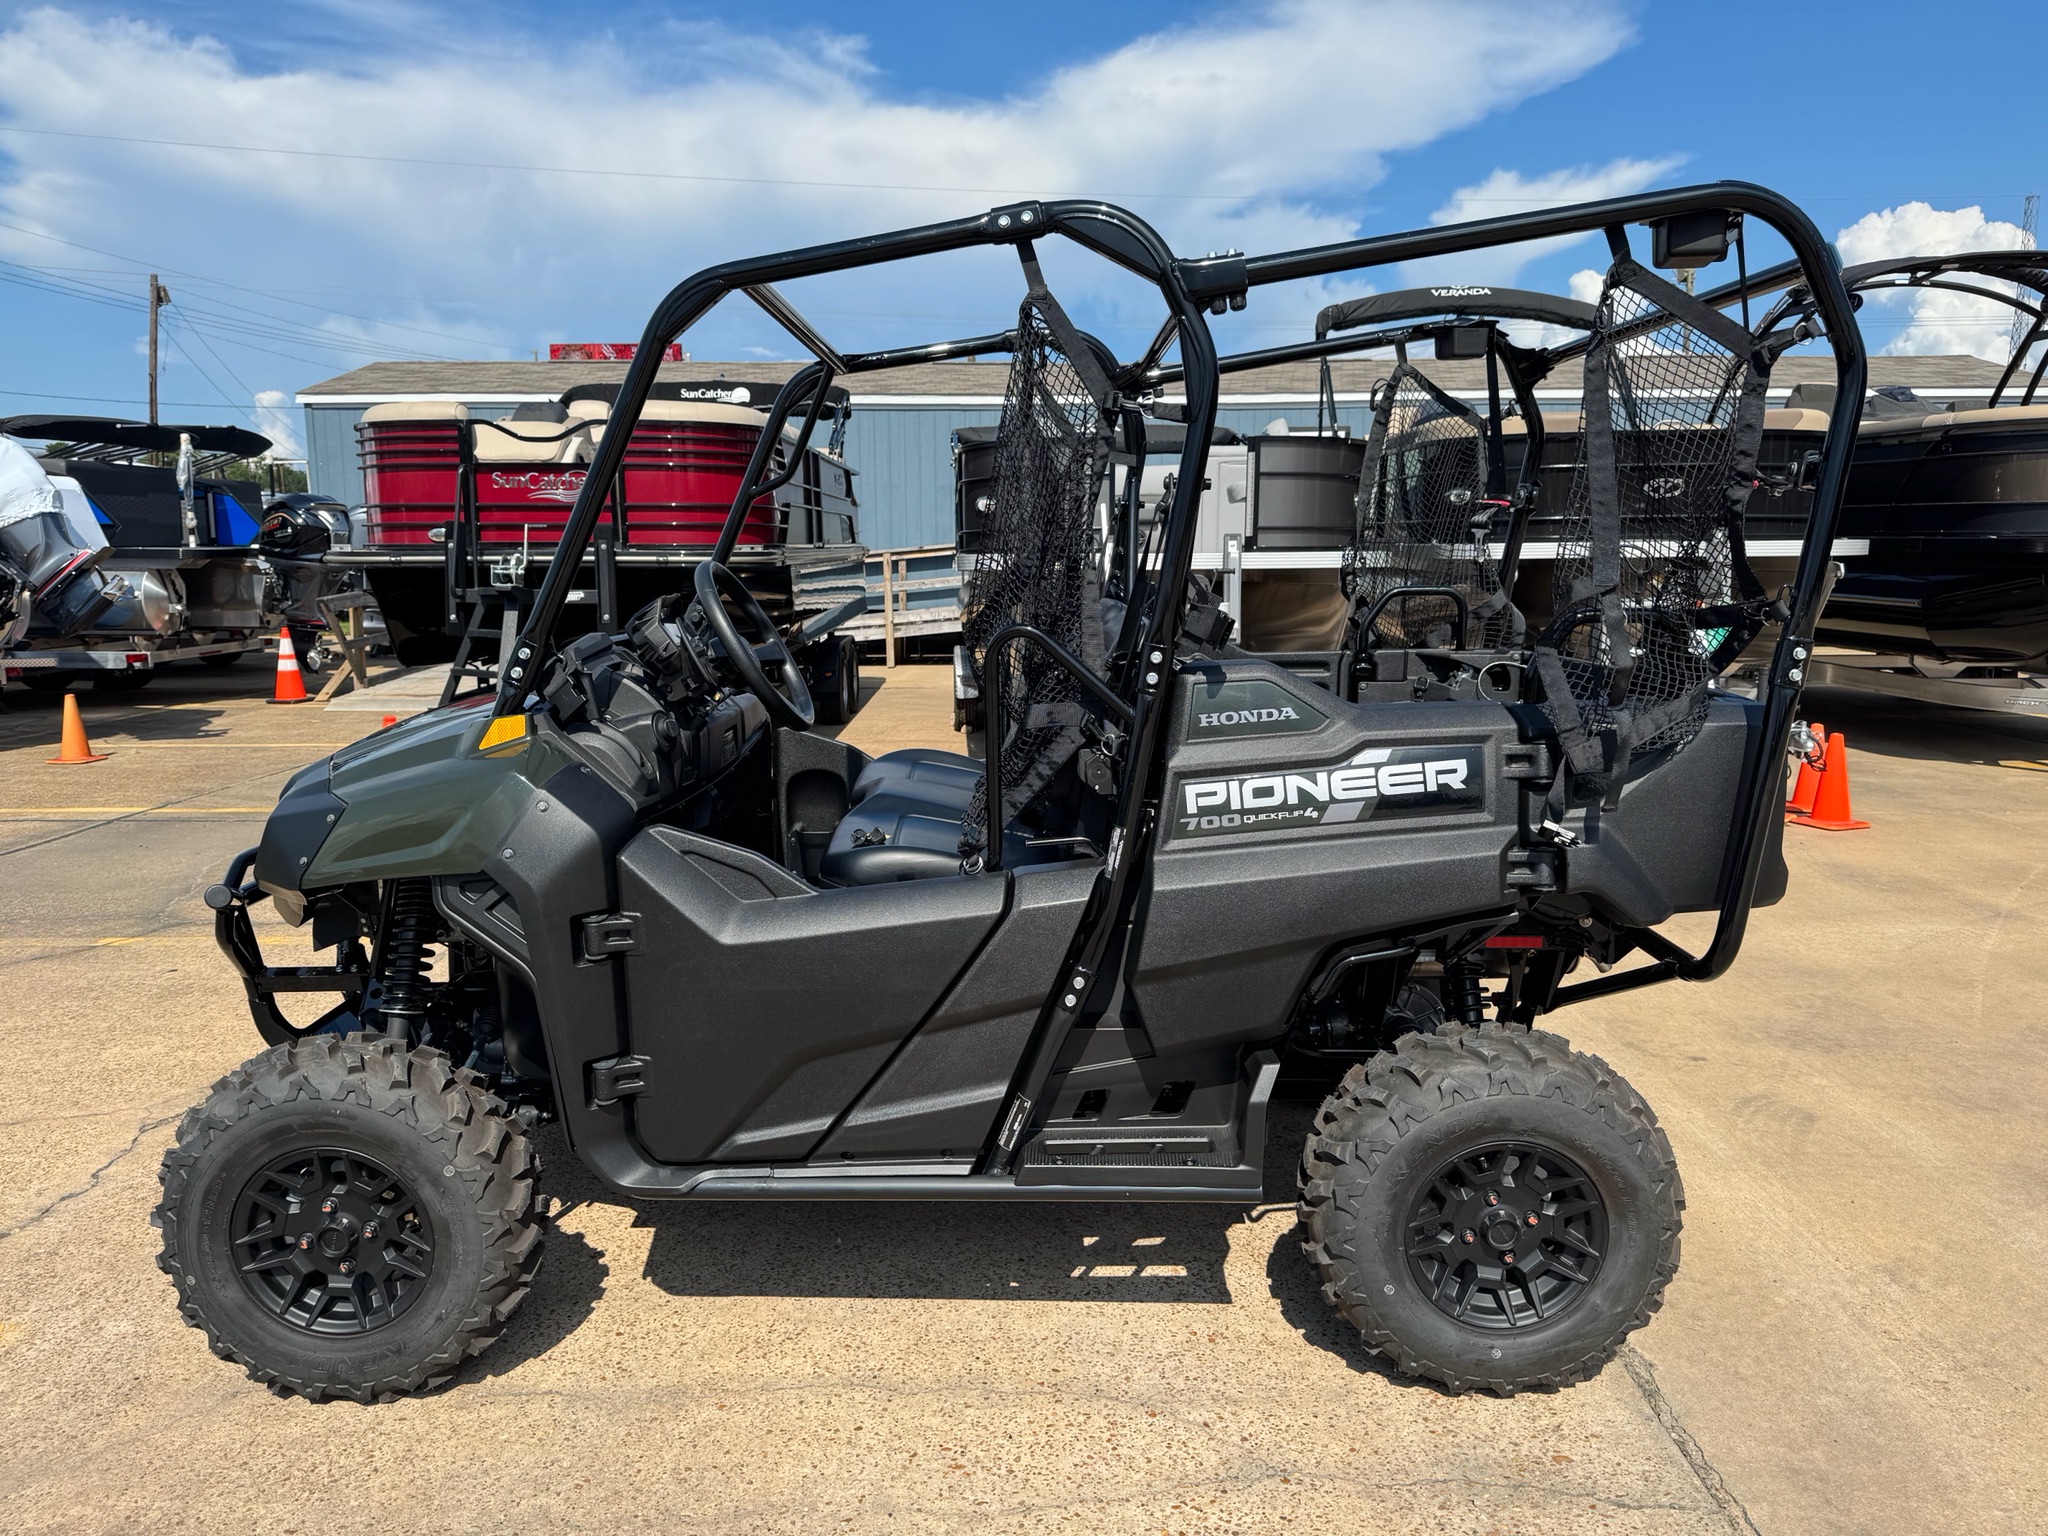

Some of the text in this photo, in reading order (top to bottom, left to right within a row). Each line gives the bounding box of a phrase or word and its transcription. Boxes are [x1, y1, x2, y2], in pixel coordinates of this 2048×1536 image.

[1430, 287, 1492, 297] VERANDA
[680, 388, 733, 399] SunCatcher
[492, 471, 585, 490] SunCatche
[1198, 706, 1300, 727] HONDA
[1184, 758, 1468, 814] PIONEER
[1179, 813, 1242, 831] 700
[1385, 1110, 1492, 1190] KENDA
